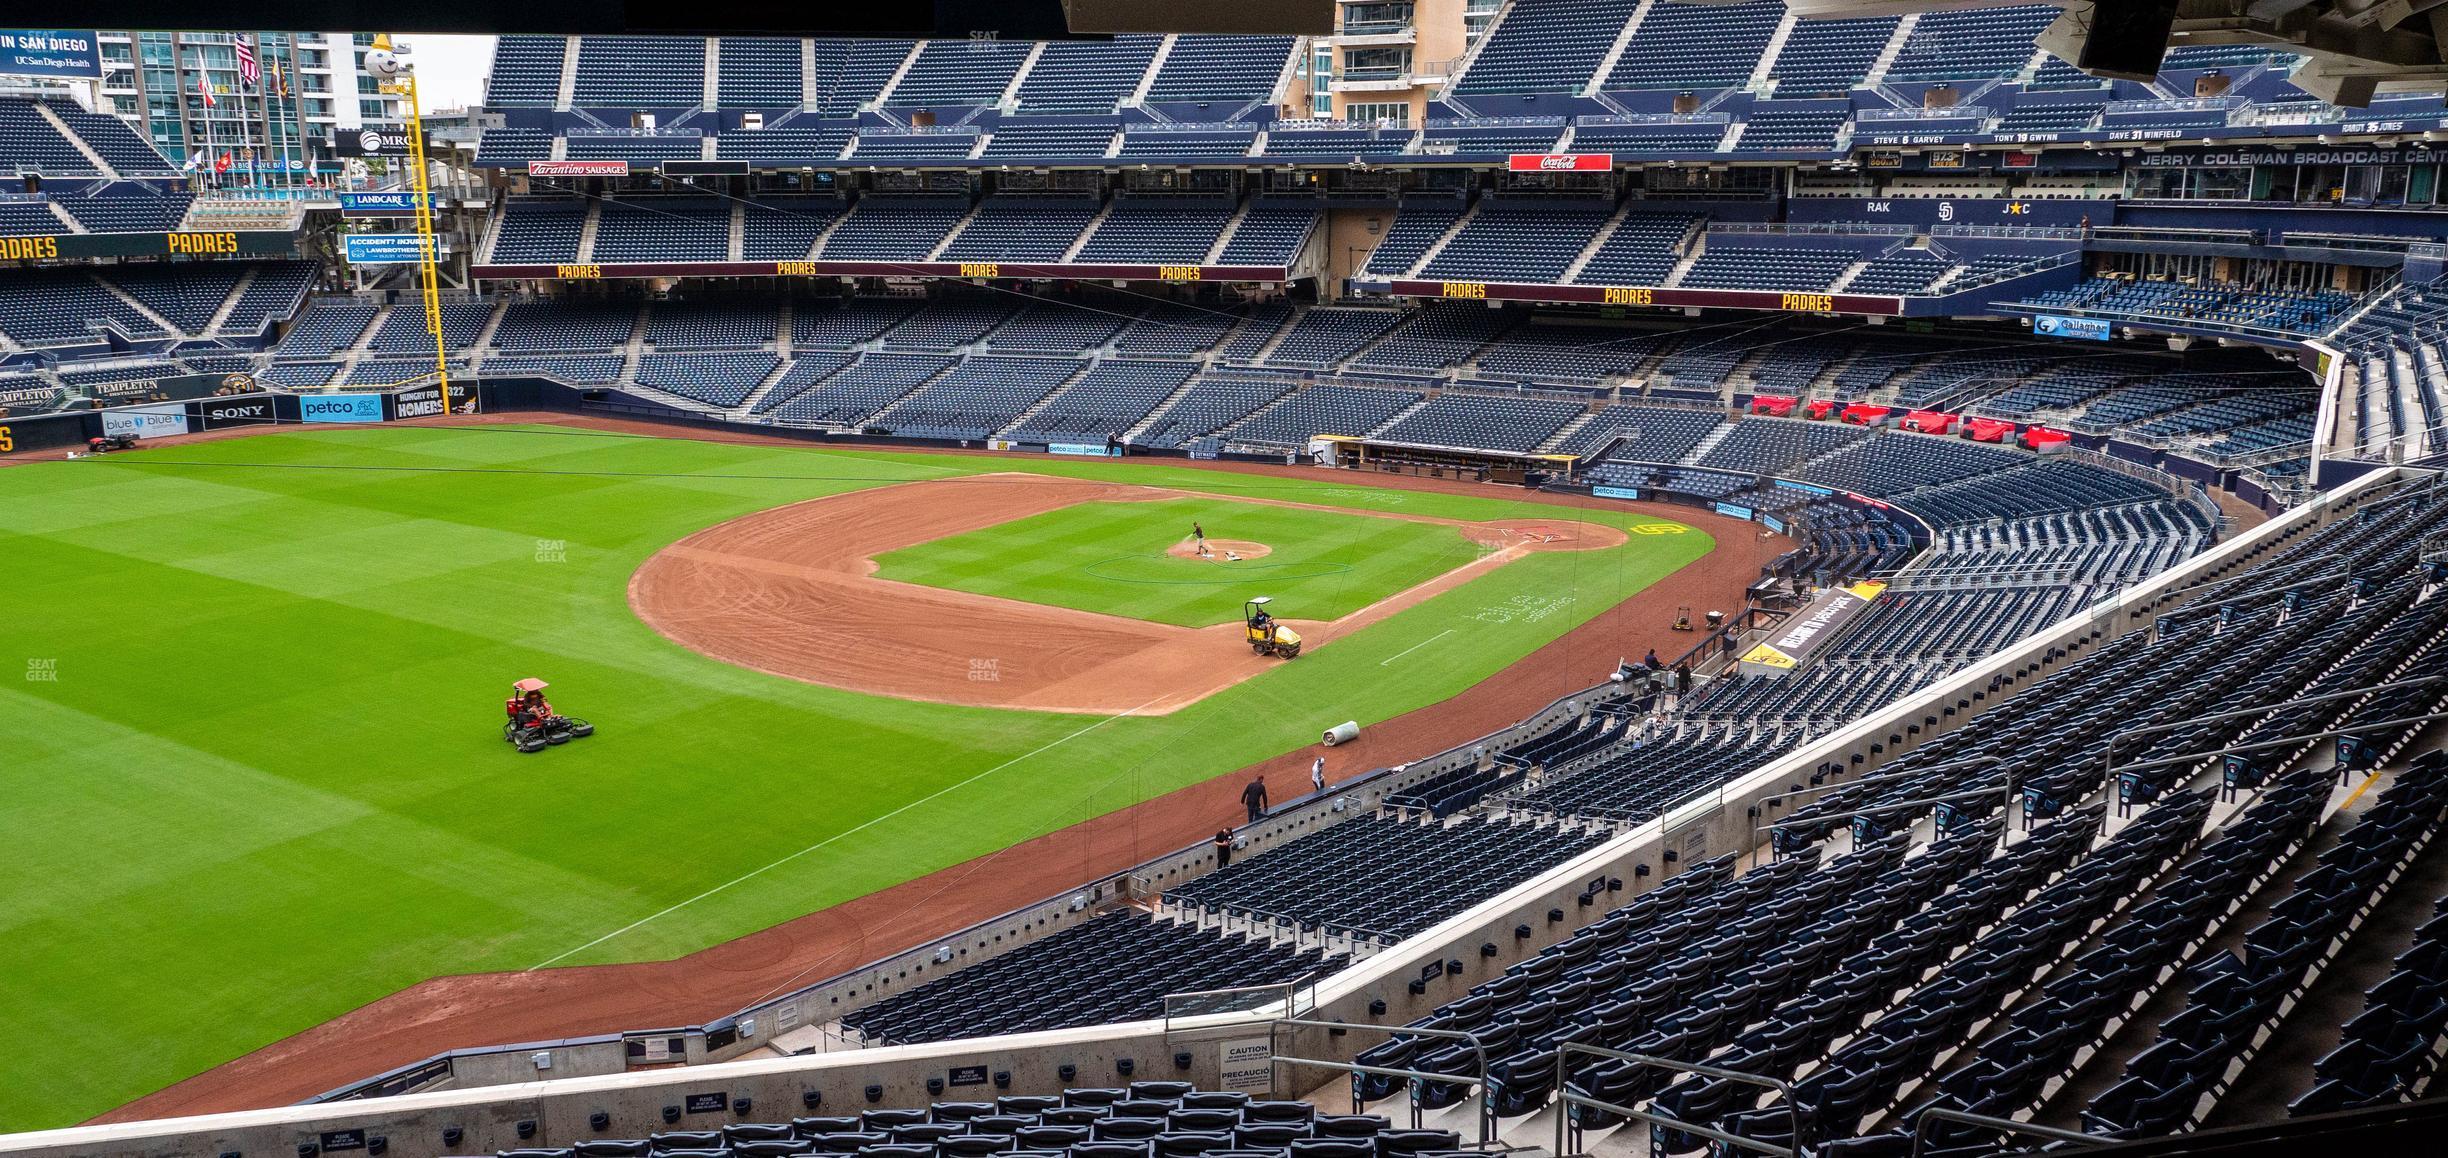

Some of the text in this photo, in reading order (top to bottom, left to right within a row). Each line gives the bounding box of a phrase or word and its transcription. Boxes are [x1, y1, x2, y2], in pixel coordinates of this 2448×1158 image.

[0, 35, 16, 48] IN
[18, 36, 46, 50] SAN
[50, 38, 88, 52] DIEGO
[15, 56, 90, 68] UC San Diego Health
[2367, 122, 2379, 132] 35
[2379, 122, 2404, 131] JONES
[382, 136, 412, 146] MRC
[1902, 136, 1909, 144] 6
[2017, 133, 2027, 142] 19
[2109, 130, 2182, 140] DAVE 31 WINFIELD
[2141, 154, 2196, 166] JERRY
[2203, 153, 2287, 165] COLEMAN
[2294, 151, 2399, 164] BROADCAST
[532, 164, 584, 174] Tarantino
[357, 196, 402, 204] LANDCARE
[1867, 202, 1890, 212] RAK
[168, 233, 238, 253] PADRES
[558, 265, 600, 278] PADRES
[777, 262, 816, 275] PADRES
[960, 264, 998, 277] PADRES
[1160, 267, 1200, 280] PADRES
[1443, 283, 1485, 298] PADRES
[1605, 288, 1651, 304] PADRES
[1782, 294, 1832, 311] PADRES
[2061, 320, 2107, 332] Gallagher
[95, 380, 158, 394] TEMPLETON
[448, 386, 464, 396] 322
[400, 390, 439, 402] HUNGRY FOR
[212, 405, 264, 420] SONY
[306, 400, 352, 417] petco
[398, 400, 444, 417] HOMERS
[106, 414, 172, 430] blue blue
[1717, 505, 1734, 513] petco
[1776, 626, 1819, 648] WELCOME
[1811, 604, 1840, 622] petco
[1230, 1045, 1267, 1055] CAUTION
[1222, 1067, 1270, 1078] PRECAUCIÓ
